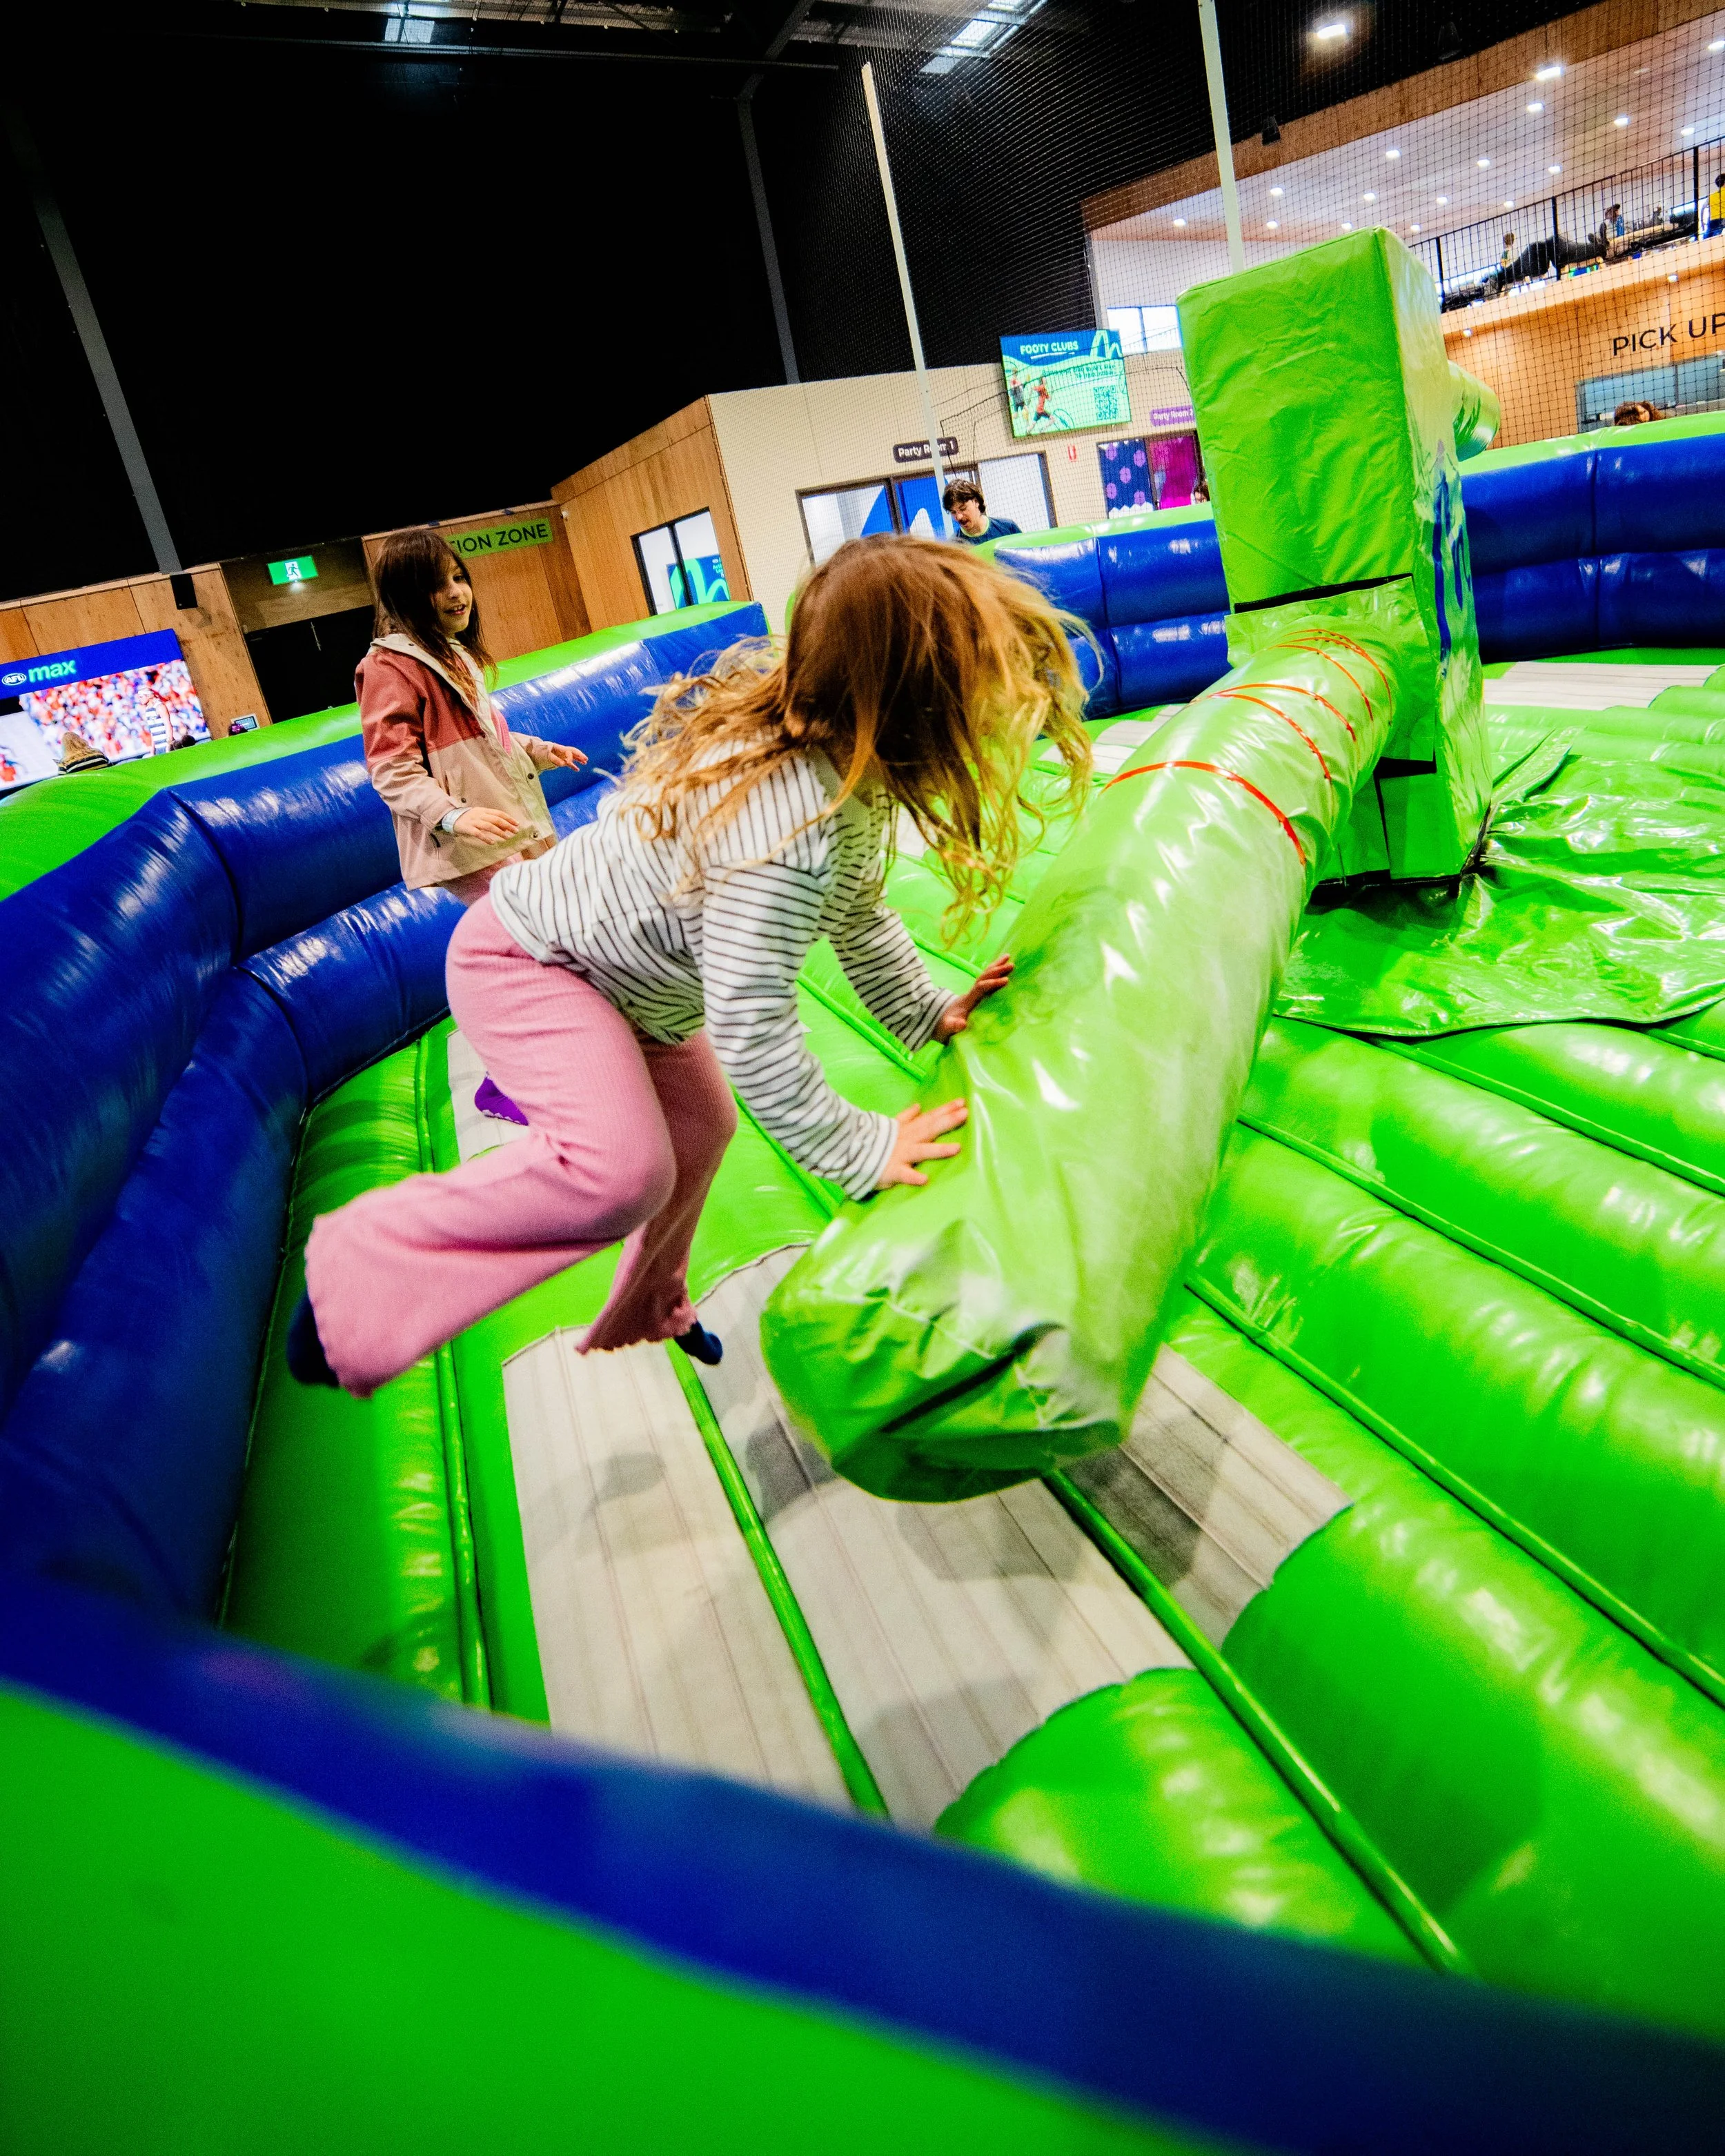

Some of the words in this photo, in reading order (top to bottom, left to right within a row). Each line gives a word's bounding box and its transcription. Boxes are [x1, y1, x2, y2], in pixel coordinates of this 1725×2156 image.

[1613, 324, 1677, 356] PICK
[1688, 312, 1725, 338] UP
[1020, 344, 1049, 355] FOOTY
[1051, 340, 1078, 352] CLUBS
[1152, 413, 1170, 421] Party
[1170, 411, 1189, 419] Room
[898, 446, 921, 457] Party
[923, 442, 947, 454] Rm
[949, 440, 954, 450] 1
[495, 524, 548, 546] ZONE
[4, 673, 25, 684] AFL
[28, 660, 77, 683] max
